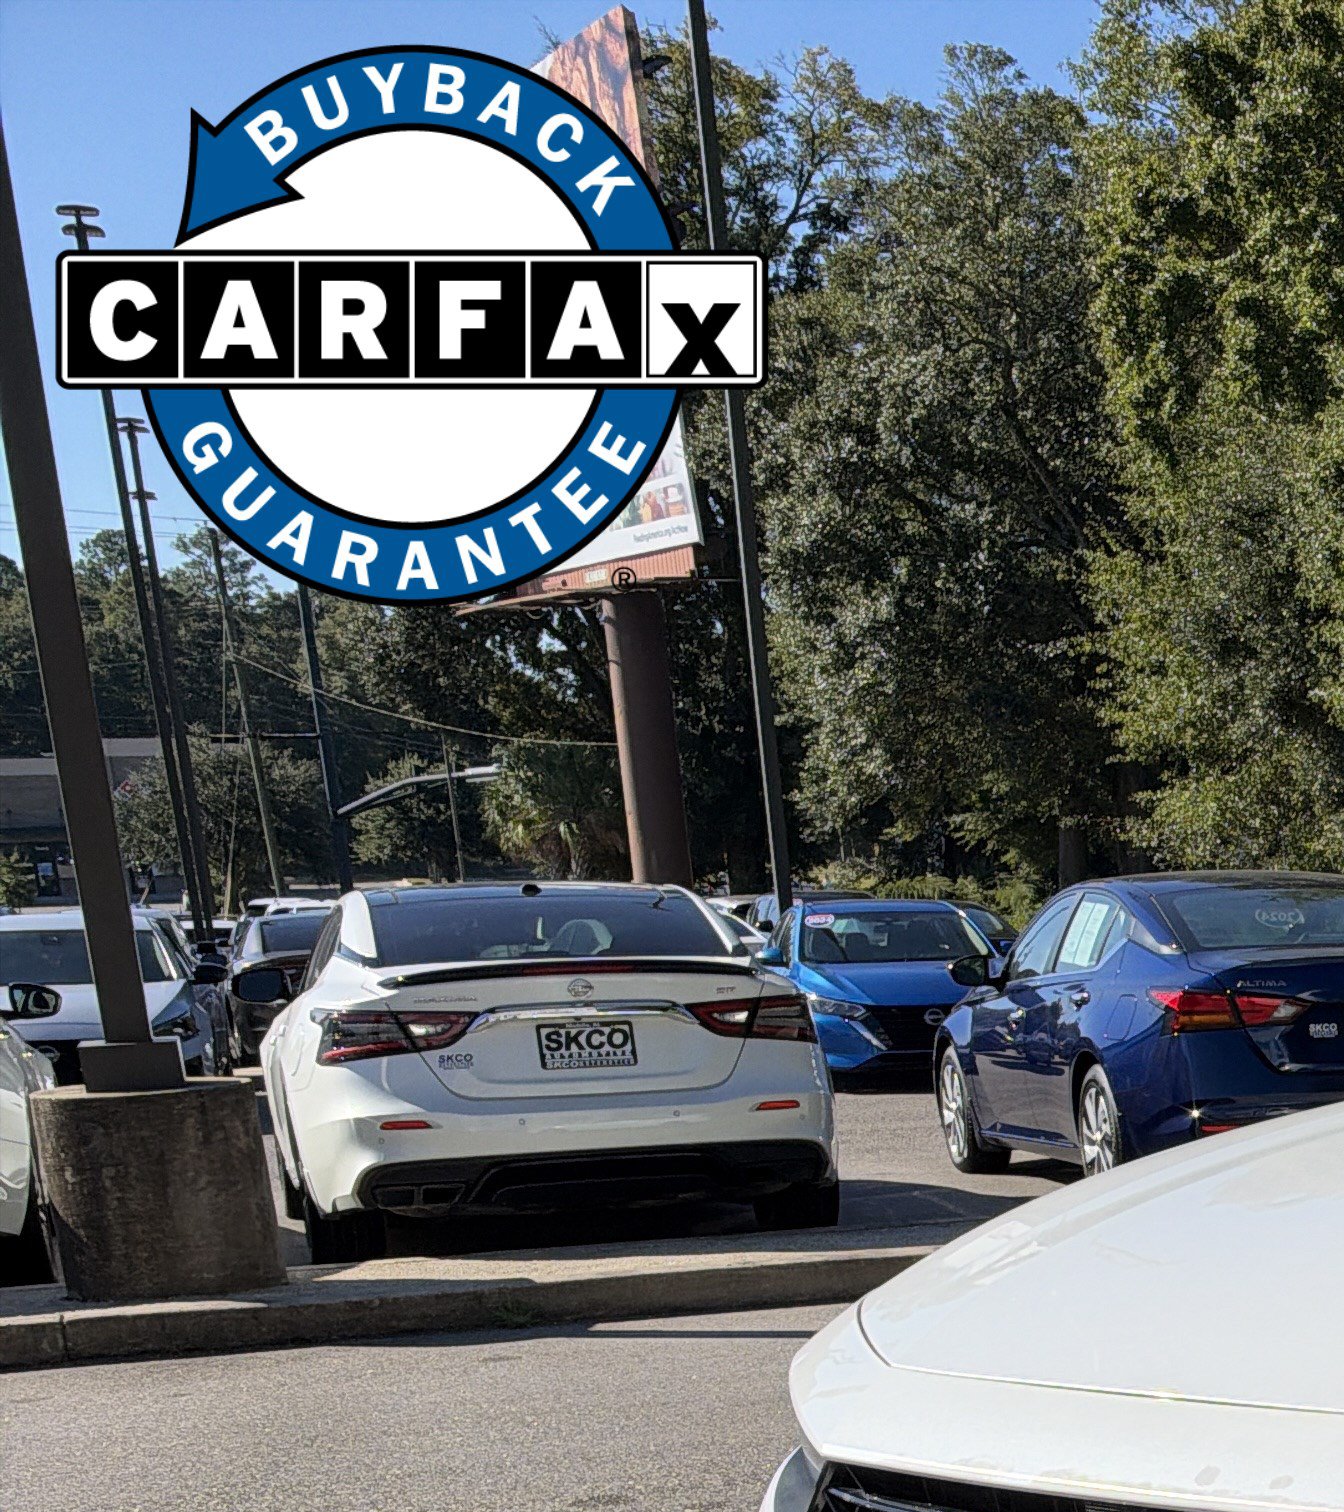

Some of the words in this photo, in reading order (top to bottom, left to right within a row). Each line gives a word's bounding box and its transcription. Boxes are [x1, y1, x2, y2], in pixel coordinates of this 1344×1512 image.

[1237, 979, 1288, 988] ALTIMA
[1309, 1023, 1338, 1032] SKCO
[545, 1028, 629, 1052] SKCO
[438, 1053, 474, 1063] SKCO
